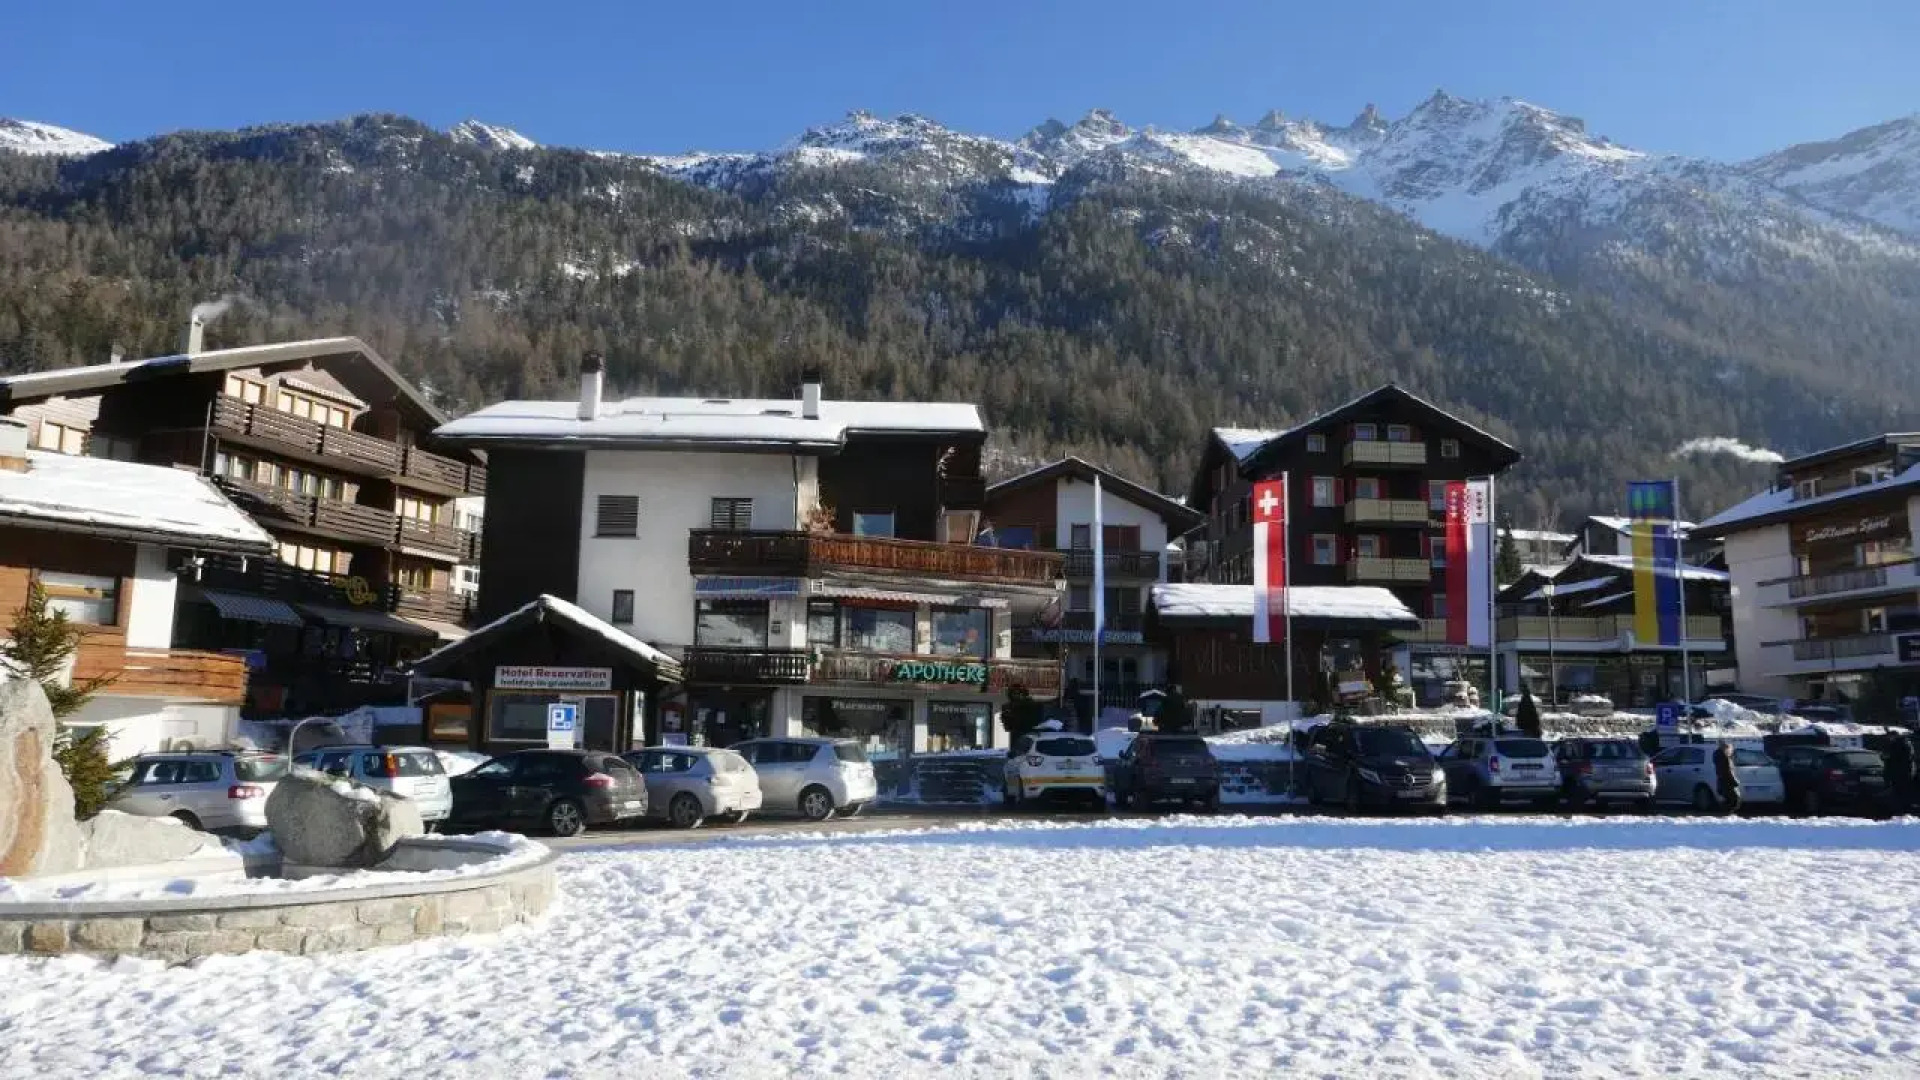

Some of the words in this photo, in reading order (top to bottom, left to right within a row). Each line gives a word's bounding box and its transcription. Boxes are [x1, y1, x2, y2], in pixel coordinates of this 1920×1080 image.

[501, 668, 533, 678] Hotel
[536, 669, 607, 679] Reservation
[898, 662, 987, 682] APOTHEKE
